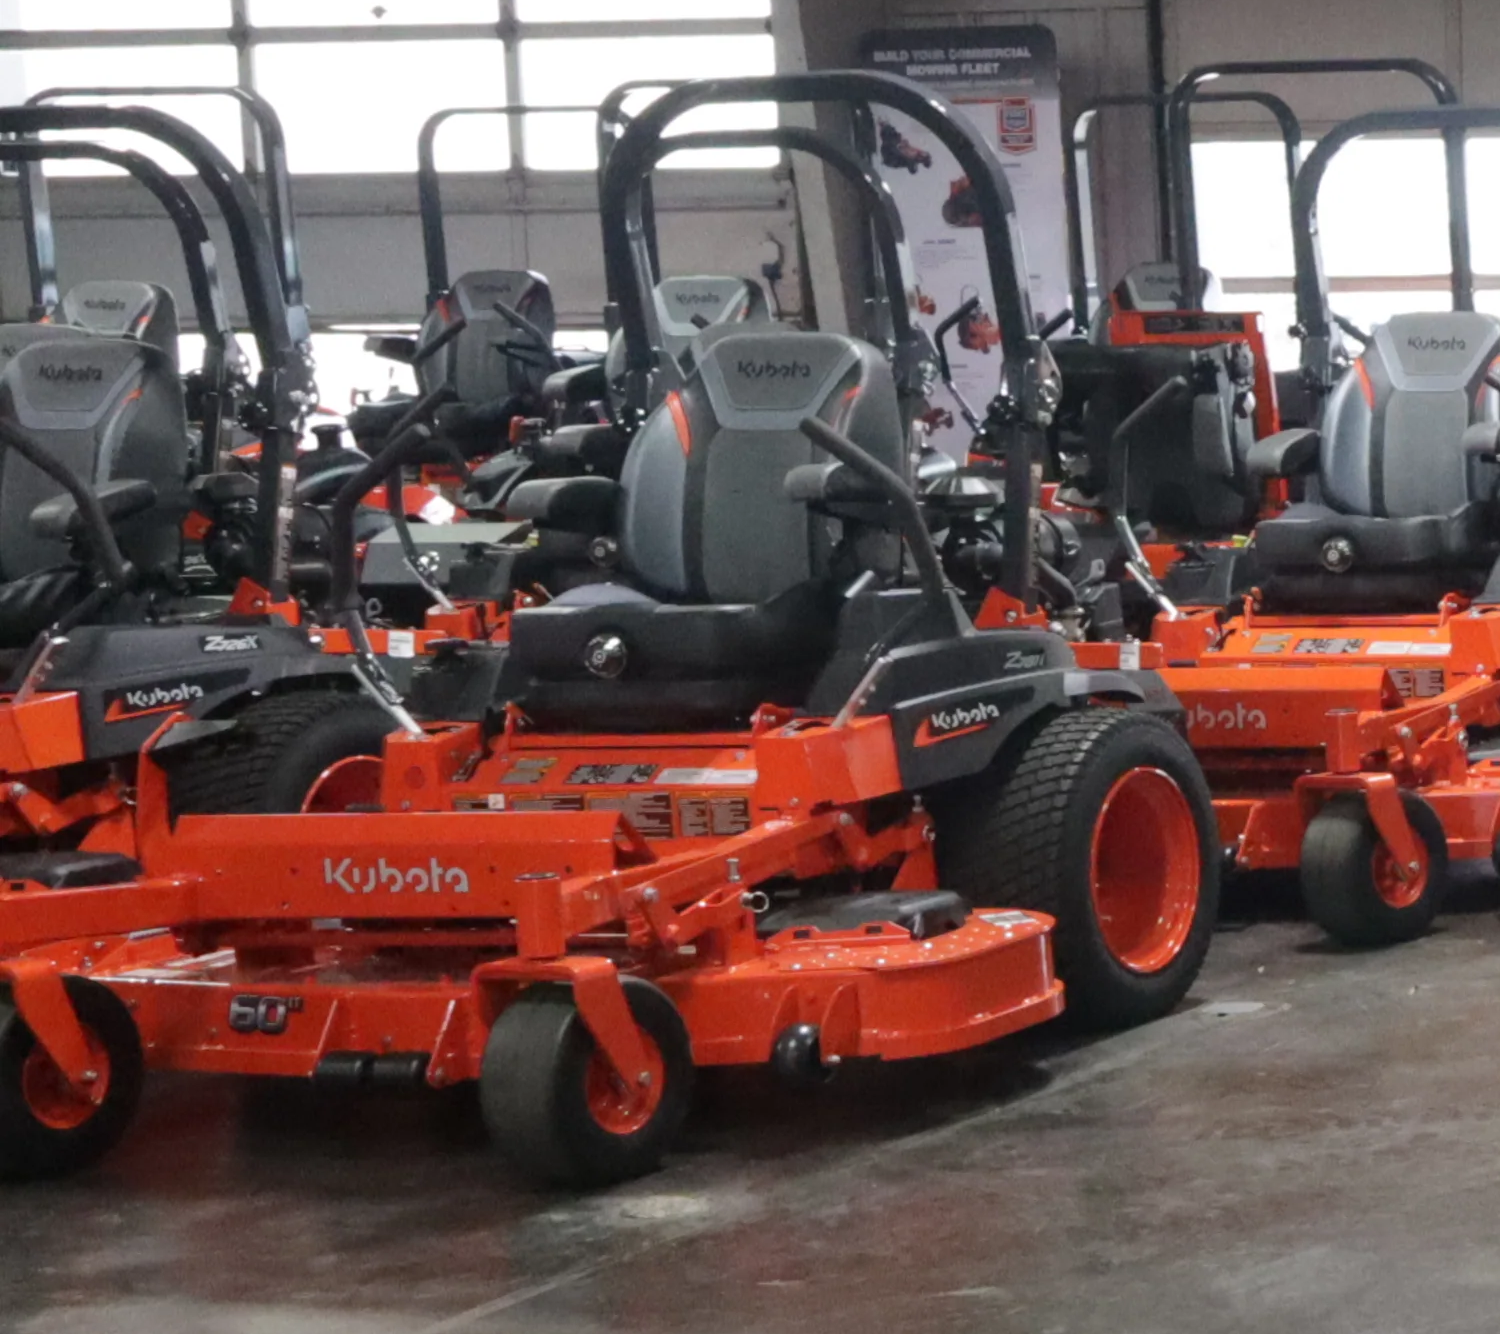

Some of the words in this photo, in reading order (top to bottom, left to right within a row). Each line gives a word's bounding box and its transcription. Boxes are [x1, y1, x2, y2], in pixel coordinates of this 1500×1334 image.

[912, 48, 945, 62] YOUR
[948, 46, 1032, 61] COMMERCIAL
[906, 63, 957, 77] MOWING
[961, 61, 1000, 75] FLEET
[1407, 335, 1466, 350] Kubota
[38, 363, 103, 383] Kubota
[736, 359, 812, 378] Kubota
[126, 682, 204, 707] Kubota
[931, 701, 1000, 730] Kubota
[1186, 702, 1267, 730] ubota
[323, 856, 469, 895] Kubota
